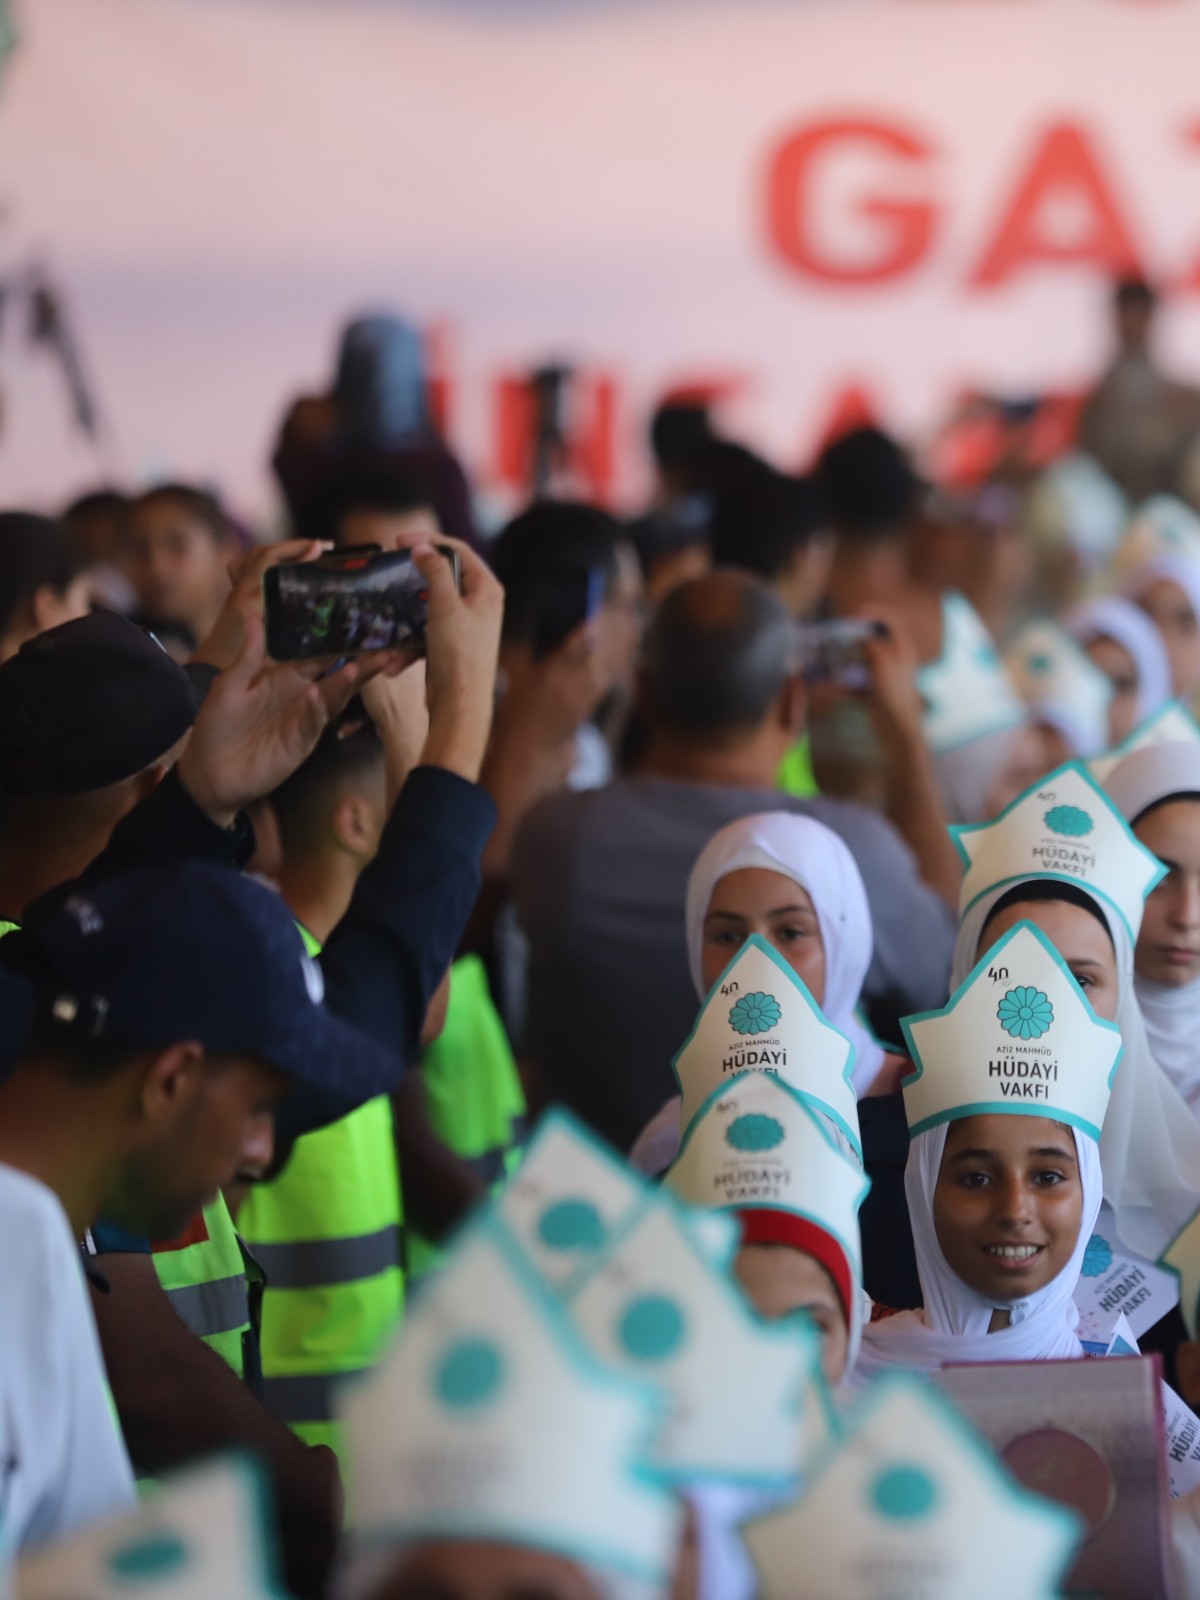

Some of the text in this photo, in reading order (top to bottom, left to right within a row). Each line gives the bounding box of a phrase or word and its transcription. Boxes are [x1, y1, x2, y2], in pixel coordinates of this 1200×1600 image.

[722, 1048, 787, 1073] HÜDÂYİ
[988, 1056, 1058, 1081] HÜDÂYİ
[1000, 1081, 1049, 1100] VAKFI
